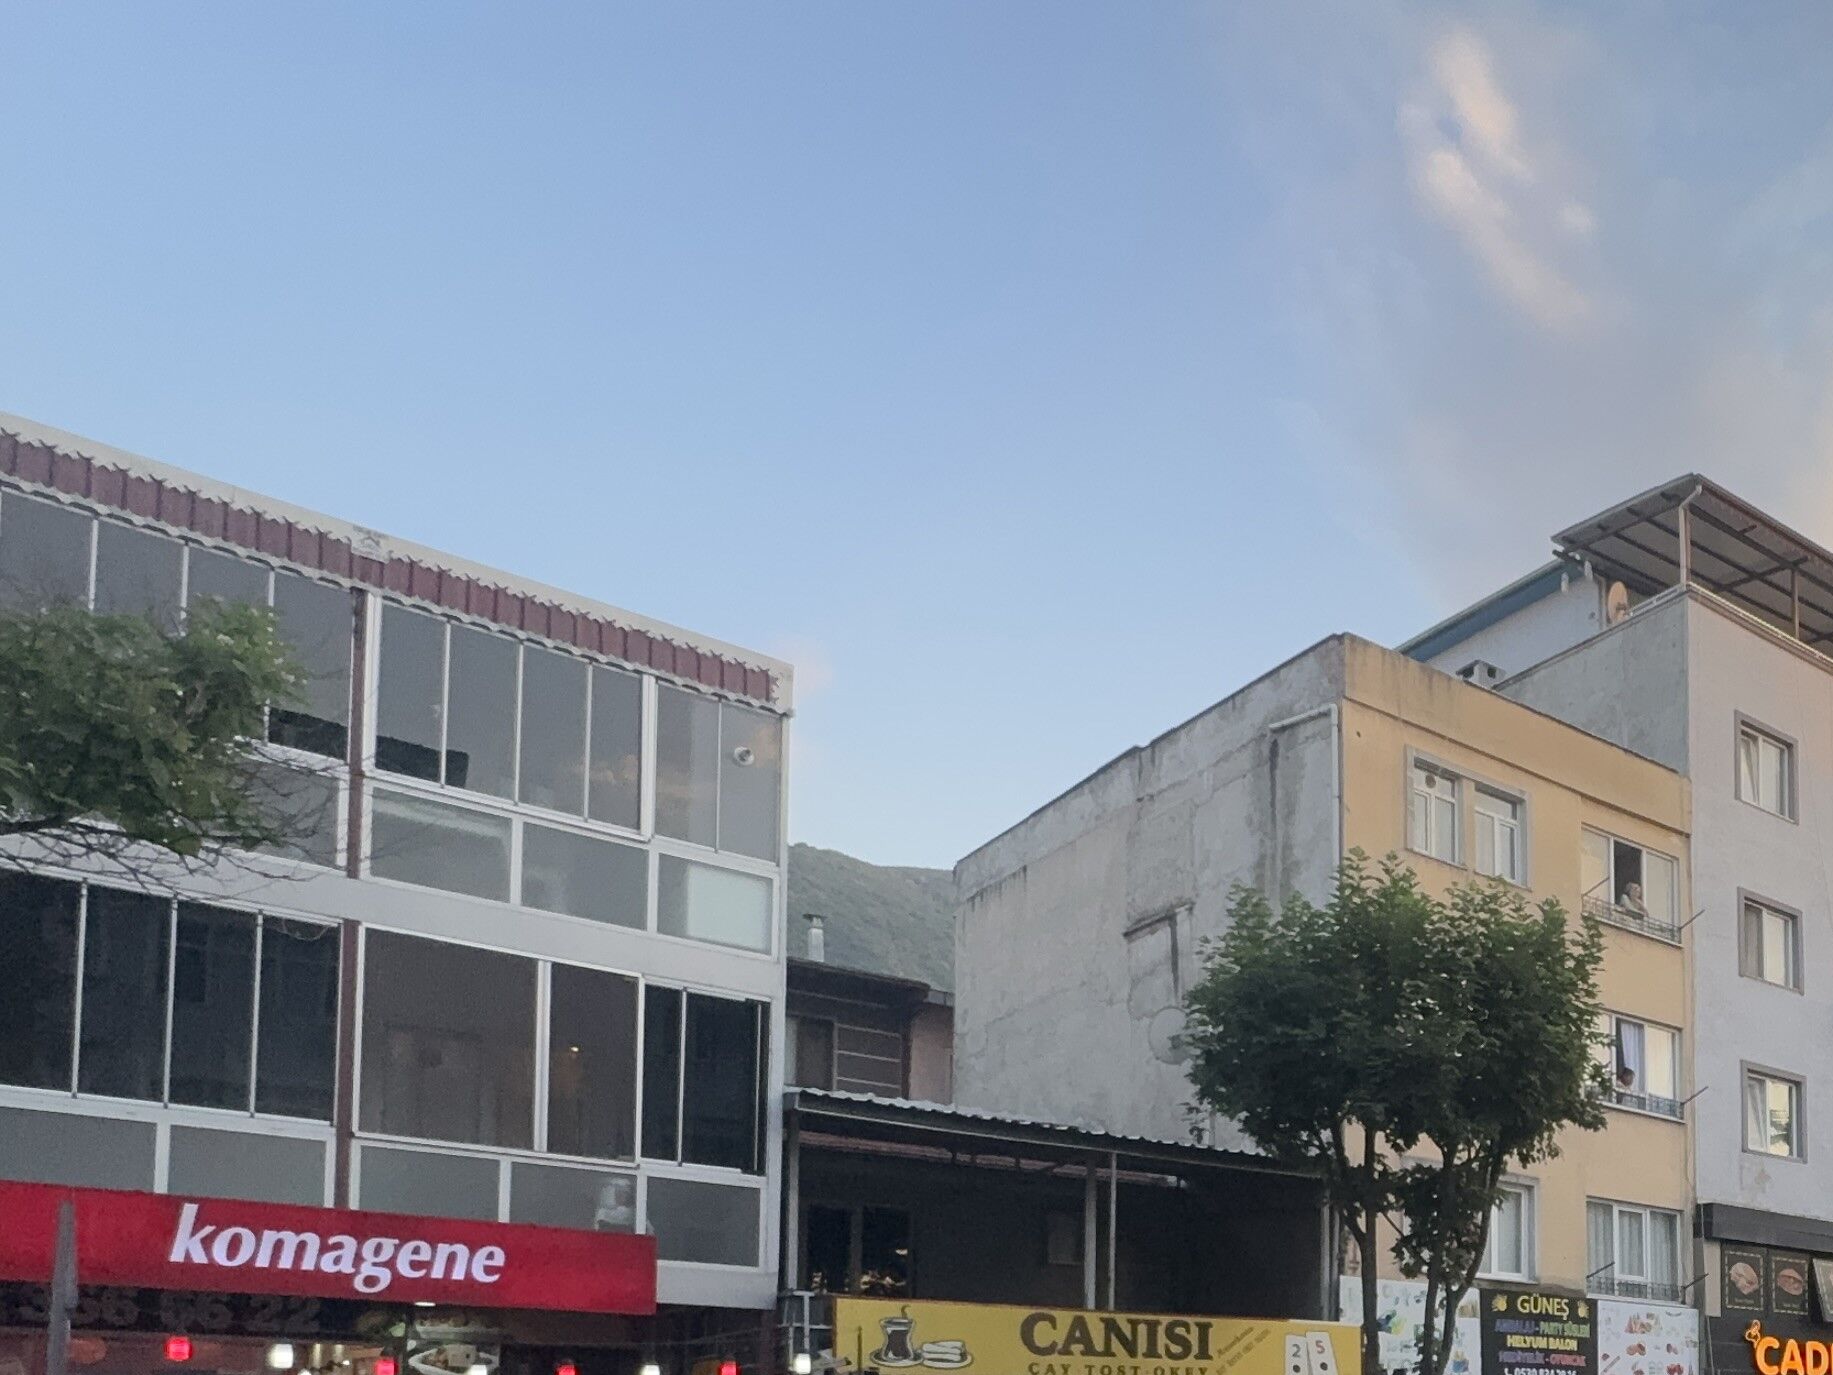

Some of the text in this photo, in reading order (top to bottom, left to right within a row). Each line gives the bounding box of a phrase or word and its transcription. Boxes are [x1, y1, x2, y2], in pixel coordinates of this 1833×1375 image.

[169, 1204, 505, 1292] komagene
[1517, 1293, 1570, 1320] GÜNEŞ
[1019, 1312, 1215, 1361] CANISI
[1316, 1336, 1326, 1354] 5
